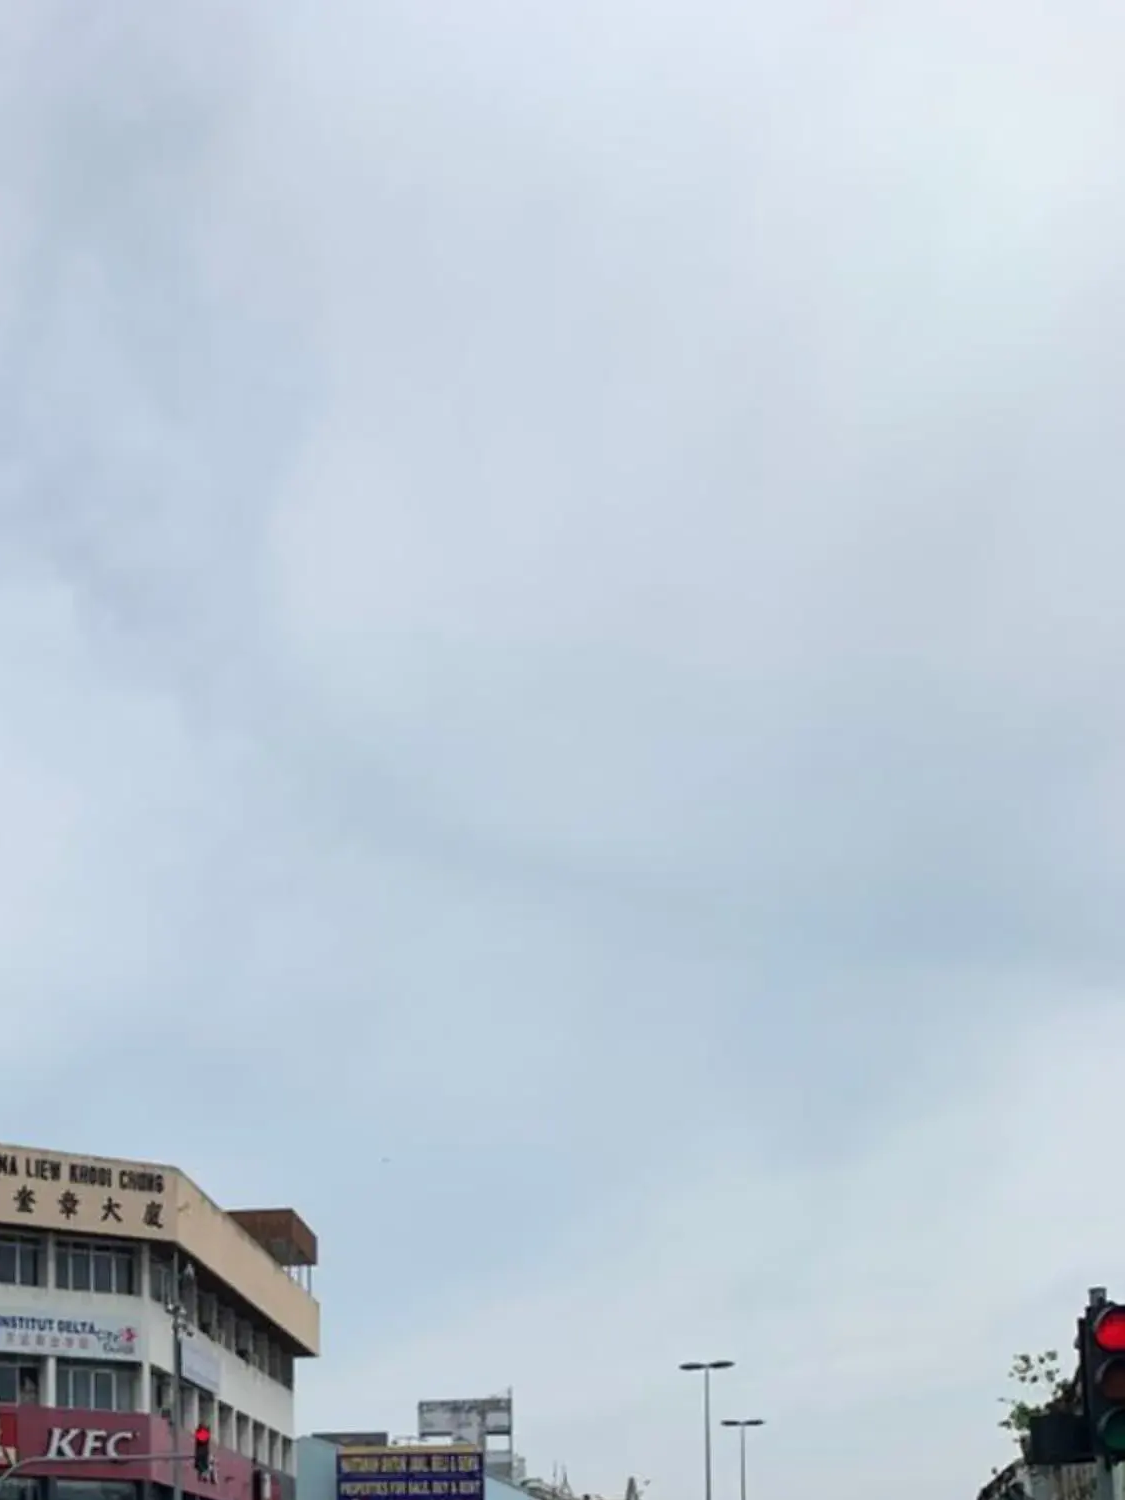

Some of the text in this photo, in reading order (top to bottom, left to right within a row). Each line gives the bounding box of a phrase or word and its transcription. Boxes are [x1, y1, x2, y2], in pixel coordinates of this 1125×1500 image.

[26, 1158, 61, 1181] LIEW
[57, 1320, 95, 1334] DELTA
[47, 1427, 134, 1461] KFC
